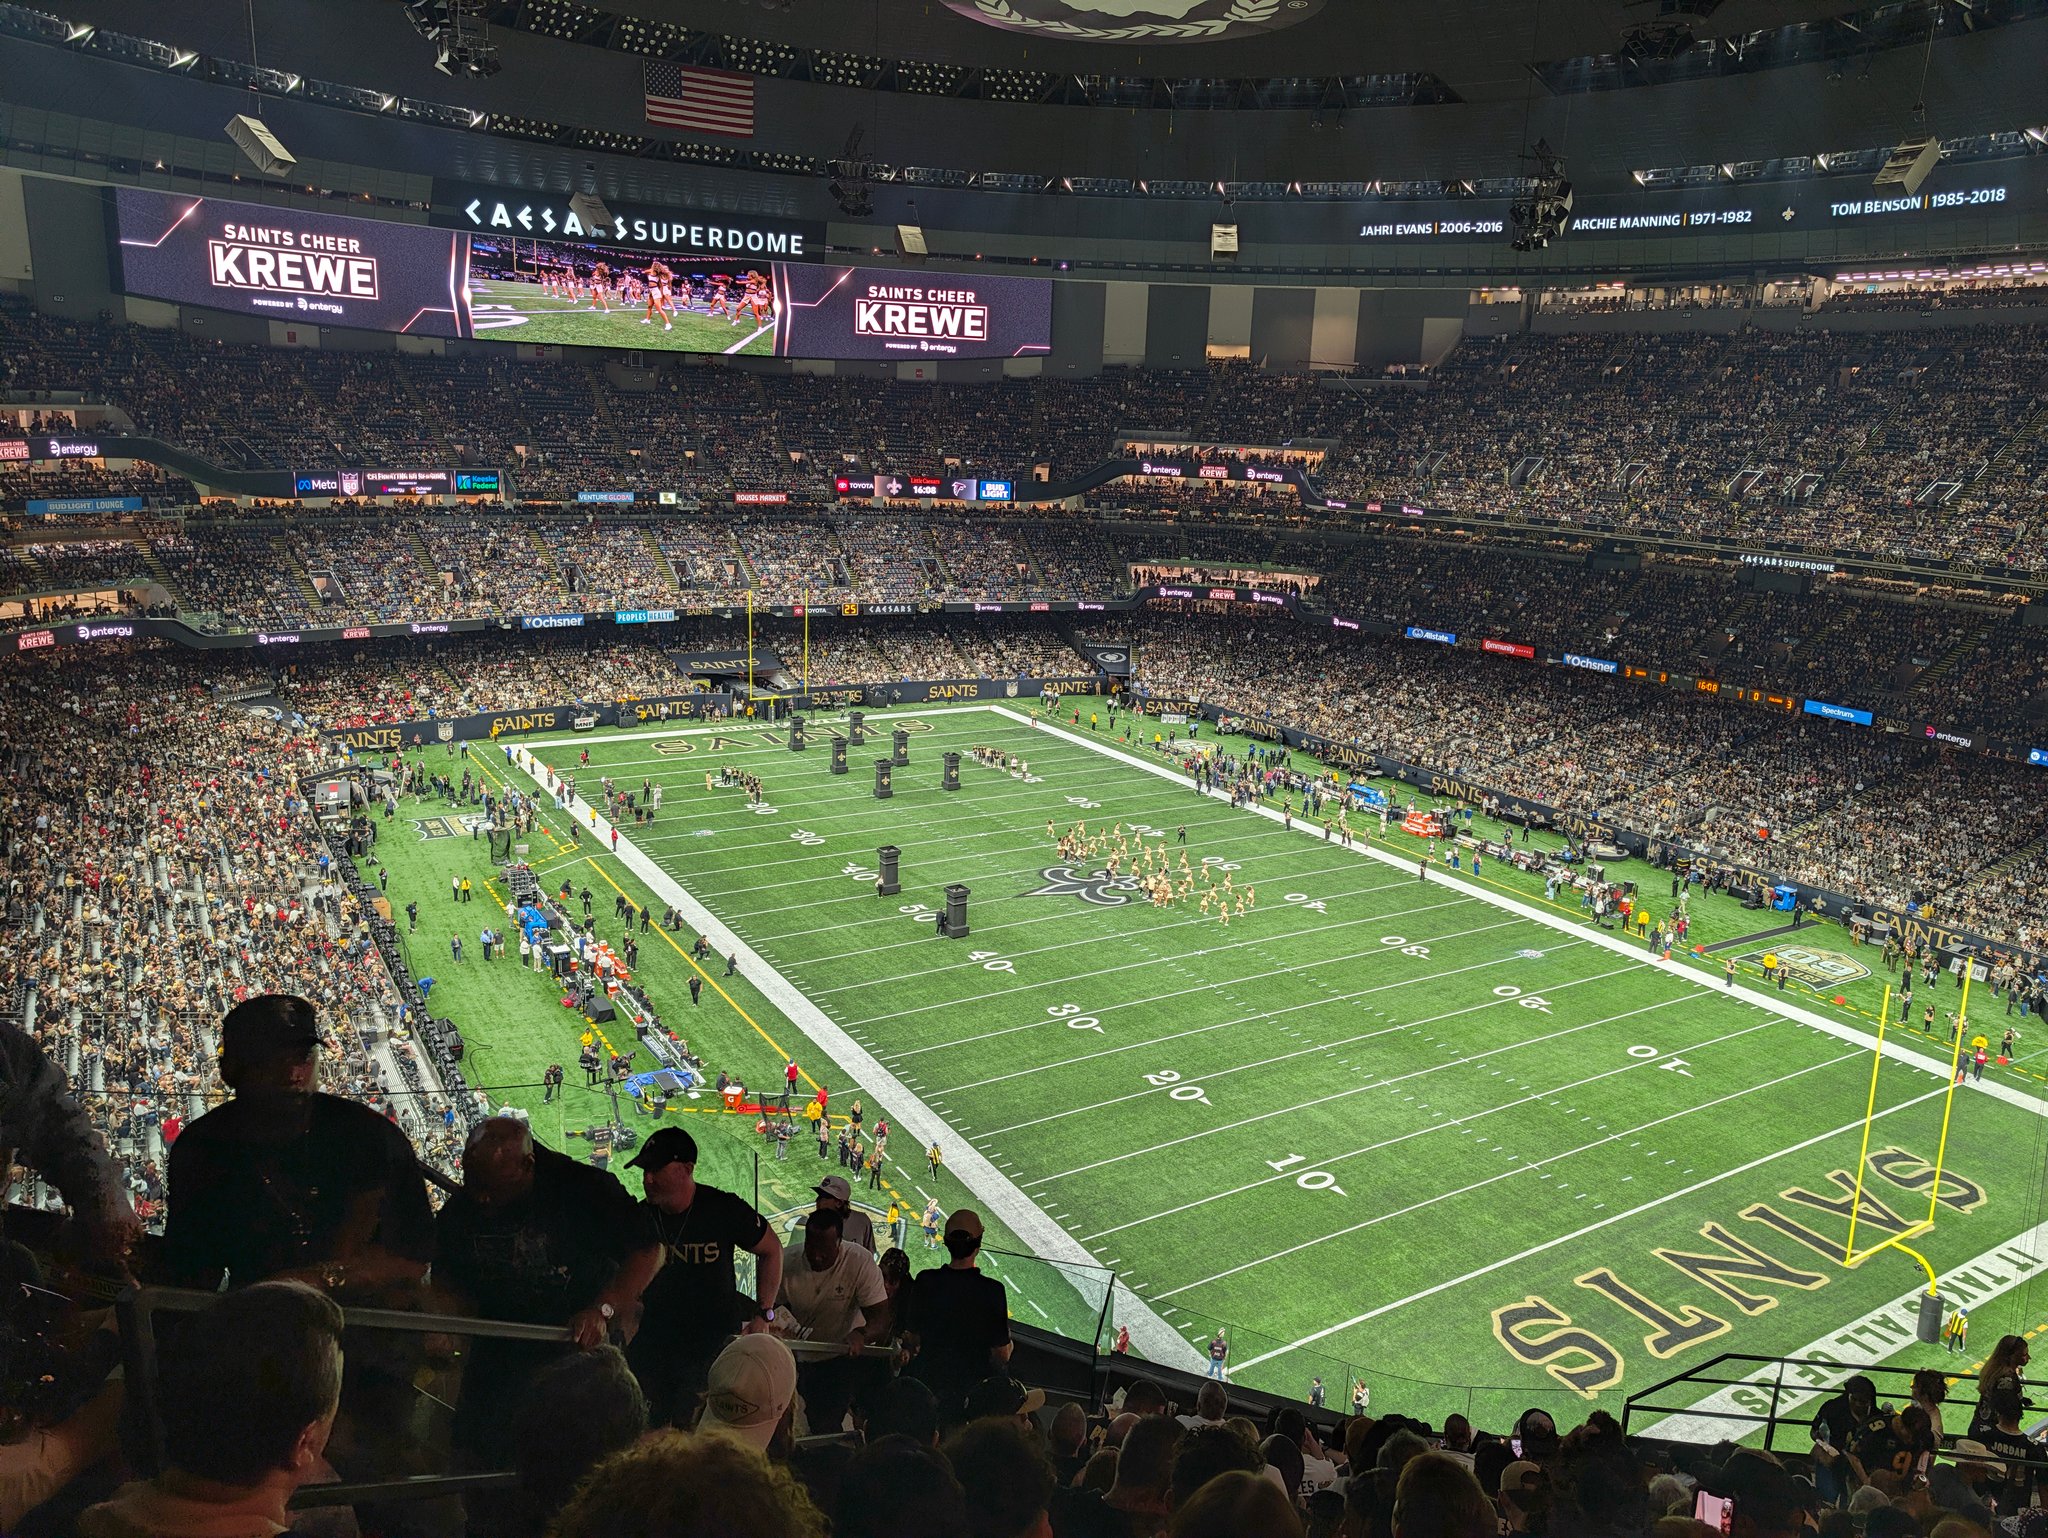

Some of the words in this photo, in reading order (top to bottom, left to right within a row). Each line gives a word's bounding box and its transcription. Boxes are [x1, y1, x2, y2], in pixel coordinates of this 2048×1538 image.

[1831, 202, 1861, 217] TOM
[1864, 196, 1922, 214] BENSON
[1931, 188, 2006, 208] 1985-2018
[465, 199, 628, 241] CAESAS
[633, 220, 804, 255] SUPERDOME
[1572, 217, 1617, 231] ARCHIE
[1619, 214, 1681, 229] MANNING
[1689, 210, 1752, 225] 1971-1982
[1360, 224, 1393, 237] JAHRI
[1395, 223, 1433, 236] EVANS
[1439, 221, 1503, 234] 2006-2016
[224, 223, 294, 246] SAINTS
[300, 233, 361, 254] CHEER
[213, 245, 375, 296] KREWE
[868, 285, 923, 301] SAINTS
[927, 289, 976, 303] CHEER
[252, 298, 285, 308] POWERED
[309, 302, 343, 314] entergy
[858, 302, 985, 337] KREWE
[929, 343, 956, 353] entergy
[61, 443, 97, 456] entergy
[1152, 466, 1181, 476] entergy
[1200, 469, 1228, 479] KREWE
[1256, 471, 1283, 482] entergy
[312, 479, 337, 490] Meta
[344, 482, 357, 491] 60
[472, 482, 498, 490] Federal
[913, 486, 937, 495] 16:08
[985, 483, 1005, 491] BUD
[578, 493, 608, 501] VENTURE
[608, 493, 634, 501] GLOBAL
[736, 494, 757, 502] ROUSES
[758, 494, 786, 502] MARKETS
[982, 490, 1009, 498] LIGHT
[49, 502, 61, 511] BUD
[61, 502, 92, 510] LIGHT
[96, 500, 124, 510] LOUNGE
[1558, 520, 1584, 530] SAINTS
[1615, 526, 1641, 536] SAINTS
[1673, 532, 1701, 543] SAINTS
[1736, 539, 1766, 550] SAINTS
[1802, 546, 1834, 557] SAINTS
[1739, 554, 1783, 566] CAESARS
[1783, 559, 1835, 573] SUPERDOME
[1873, 552, 1907, 565] SAINTS
[1862, 568, 1894, 579] SAINTS
[1948, 562, 1985, 575] SAINTS
[1933, 576, 1967, 588] SAINTS
[1167, 588, 1193, 598] entergy
[1209, 591, 1236, 600] KREWE
[2009, 586, 2045, 598] SAINTS
[919, 602, 942, 610] SAINTS
[1261, 594, 1284, 605] entergy
[686, 608, 713, 616] SAINTS
[843, 604, 857, 614] 25
[868, 605, 912, 613] CAESARS
[981, 604, 1002, 612] entergy
[1087, 603, 1105, 611] entergy
[532, 615, 583, 628] Ochsner
[617, 612, 647, 623] PEOPLES
[648, 611, 674, 621] HEALTH
[421, 624, 449, 633] entergy
[1340, 619, 1359, 629] entergy
[91, 626, 133, 638] entergy
[343, 630, 371, 639] KREWE
[1423, 631, 1449, 642] Allstate
[19, 635, 54, 650] KREWE
[269, 634, 300, 645] entergy
[1485, 640, 1516, 654] Community
[690, 657, 761, 669] SAINTS
[1571, 656, 1616, 674] Ochsner
[929, 684, 978, 699] SAINTS
[1043, 681, 1088, 694] SAINTS
[1698, 681, 1718, 693] 16:08
[1146, 700, 1199, 715] SAINTS
[1821, 705, 1850, 719] Spectrum
[493, 712, 556, 733] SAINTS
[1244, 718, 1278, 739] SAINT
[1876, 716, 1910, 730] SAINTS
[1936, 732, 1972, 747] entergy
[1431, 776, 1483, 803] SAINTS
[789, 829, 826, 845] 30
[841, 862, 880, 881] 40
[898, 903, 938, 922] 50
[1872, 910, 1964, 951] SAINTS
[1380, 935, 1424, 956] 30
[967, 949, 1012, 973] 40
[1492, 985, 1545, 1010] 20
[1047, 1003, 1099, 1030] 30
[1626, 1045, 1690, 1073] 10
[1142, 1069, 1204, 1101] 20
[727, 1095, 735, 1103] G
[1265, 1153, 1336, 1190] 10
[1995, 1246, 2044, 1273] IT
[1491, 1144, 1988, 1400] SAINTS
[1902, 1265, 2012, 1314] TAKS
[1834, 1313, 1913, 1355] ALL
[1795, 1349, 1848, 1388] OF
[1730, 1378, 1799, 1415] US
[1991, 1441, 2027, 1459] JORDAN
